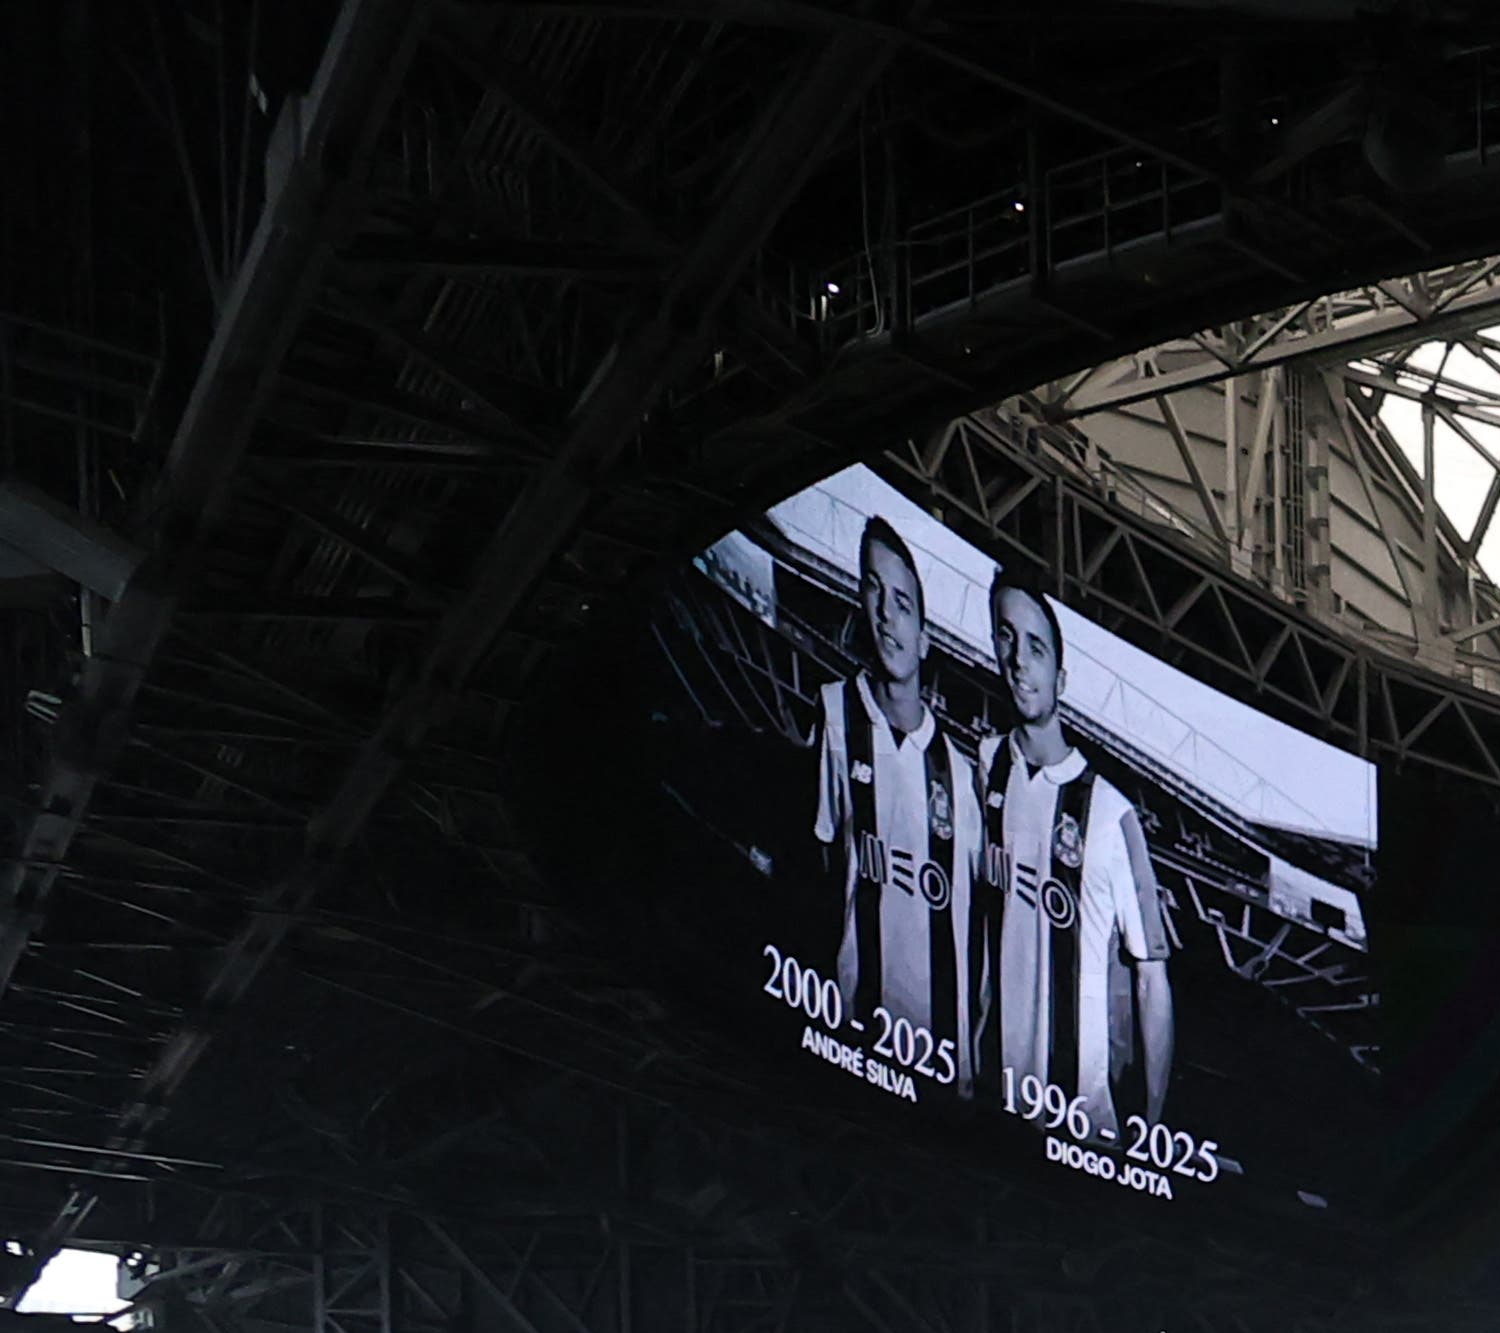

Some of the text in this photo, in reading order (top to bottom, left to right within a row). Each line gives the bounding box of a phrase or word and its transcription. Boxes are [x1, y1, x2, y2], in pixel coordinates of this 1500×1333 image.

[763, 944, 956, 1084] 2000 - 2025
[801, 1026, 918, 1103] ANDRÉ SILVA
[1002, 1066, 1219, 1182] 1996 - 2025
[1046, 1136, 1173, 1200] DIOGO JOTA
